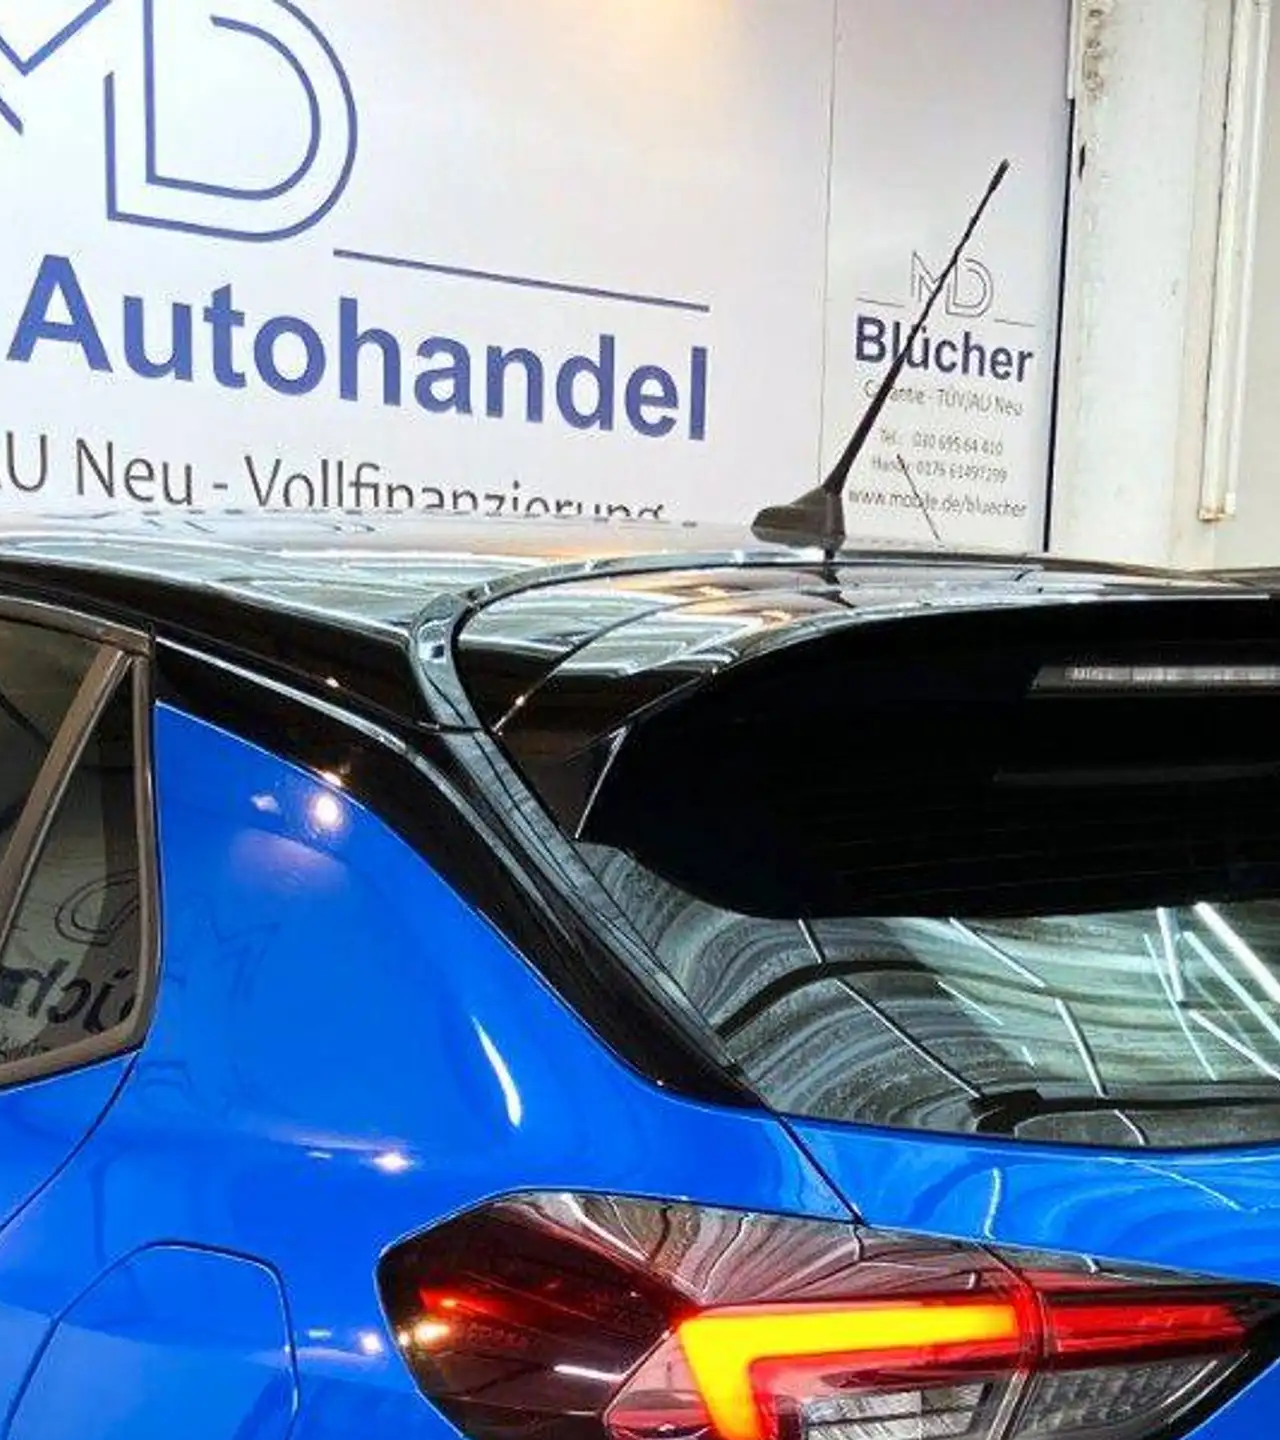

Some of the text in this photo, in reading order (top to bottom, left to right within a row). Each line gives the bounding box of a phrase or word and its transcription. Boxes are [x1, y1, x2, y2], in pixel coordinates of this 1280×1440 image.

[6, 254, 709, 441] Autohandel
[856, 315, 1033, 382] Blücher
[76, 437, 194, 506] Neu
